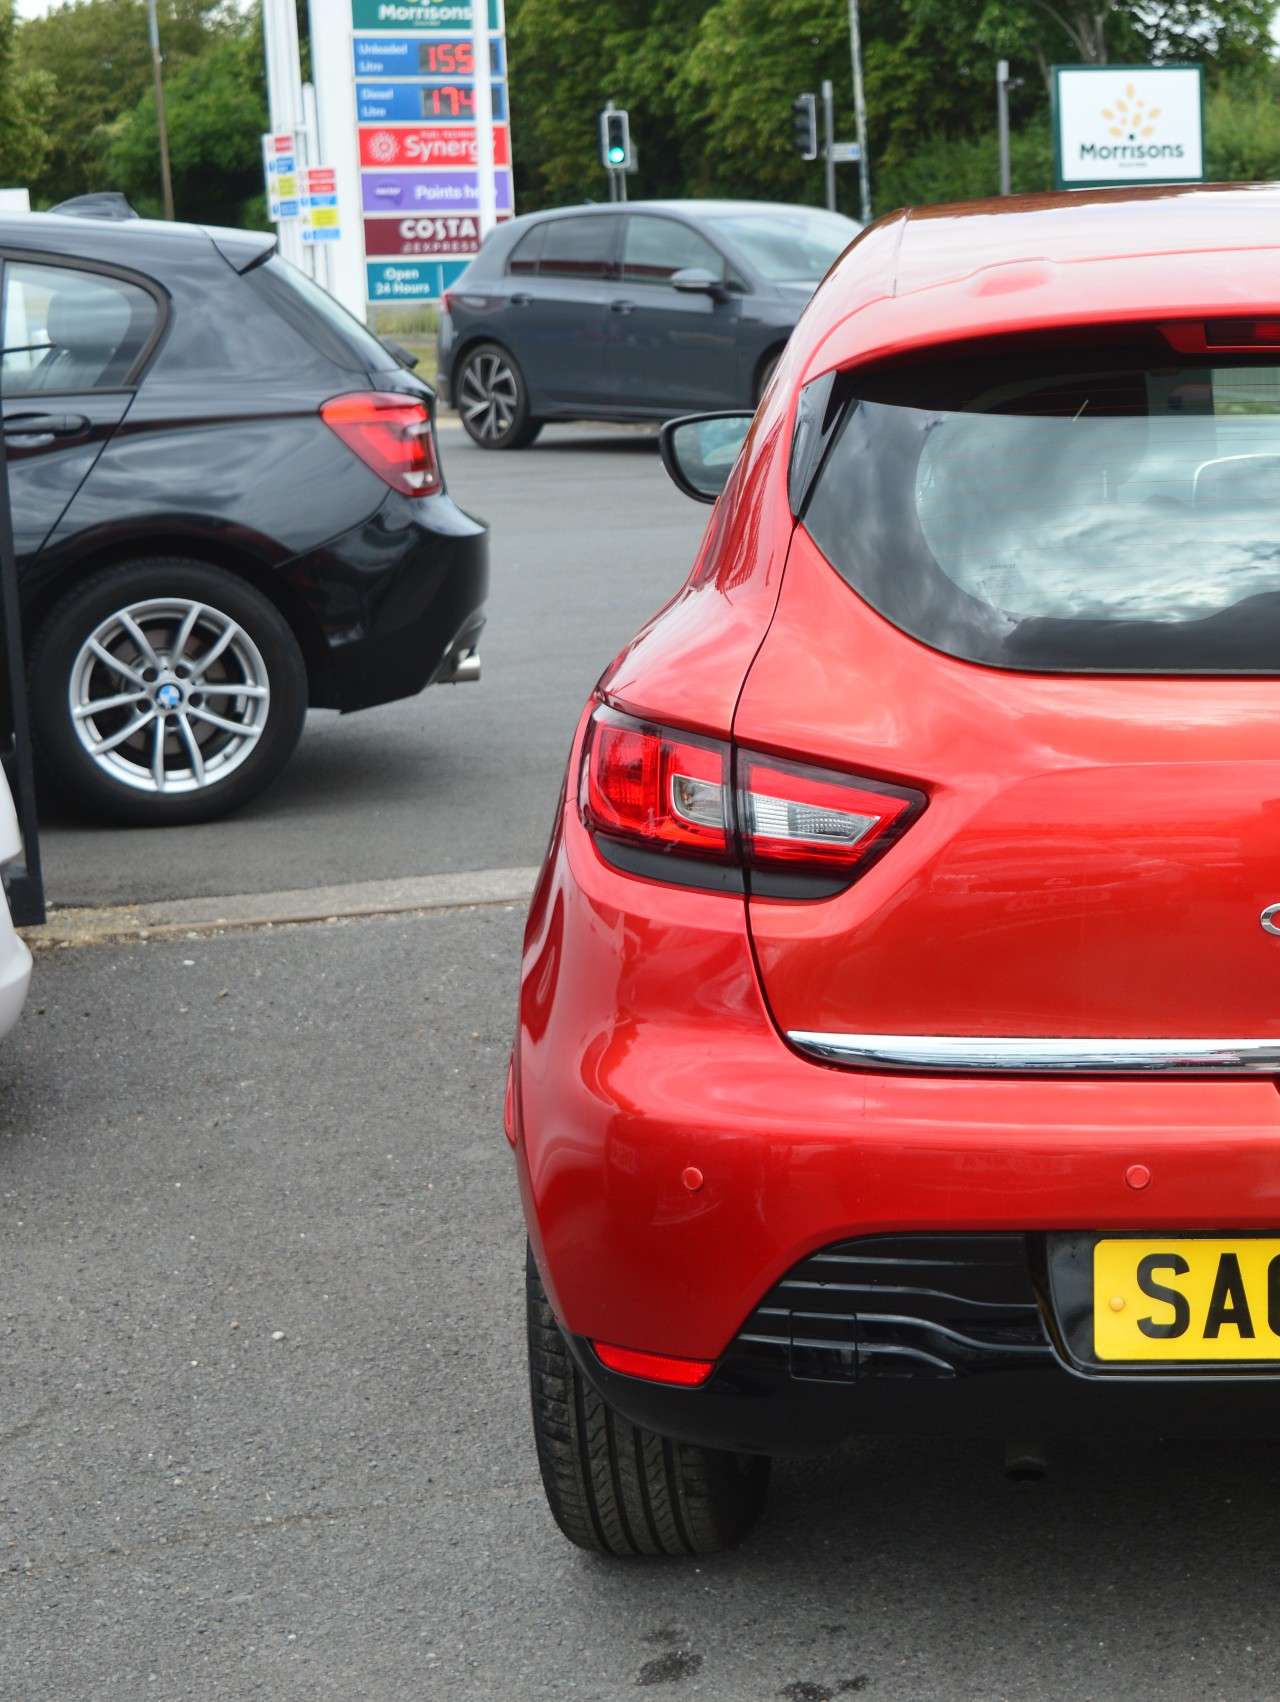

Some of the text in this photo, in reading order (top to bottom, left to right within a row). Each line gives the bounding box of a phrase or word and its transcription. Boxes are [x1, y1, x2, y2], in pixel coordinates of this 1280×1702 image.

[378, 4, 473, 20] Morrisons
[428, 43, 475, 73] 155
[404, 134, 495, 162] Synerg
[1080, 143, 1184, 160] Morrisons
[415, 185, 463, 199] Points
[400, 219, 477, 240] COSTA
[384, 267, 420, 281] Open
[392, 281, 431, 295] Hours
